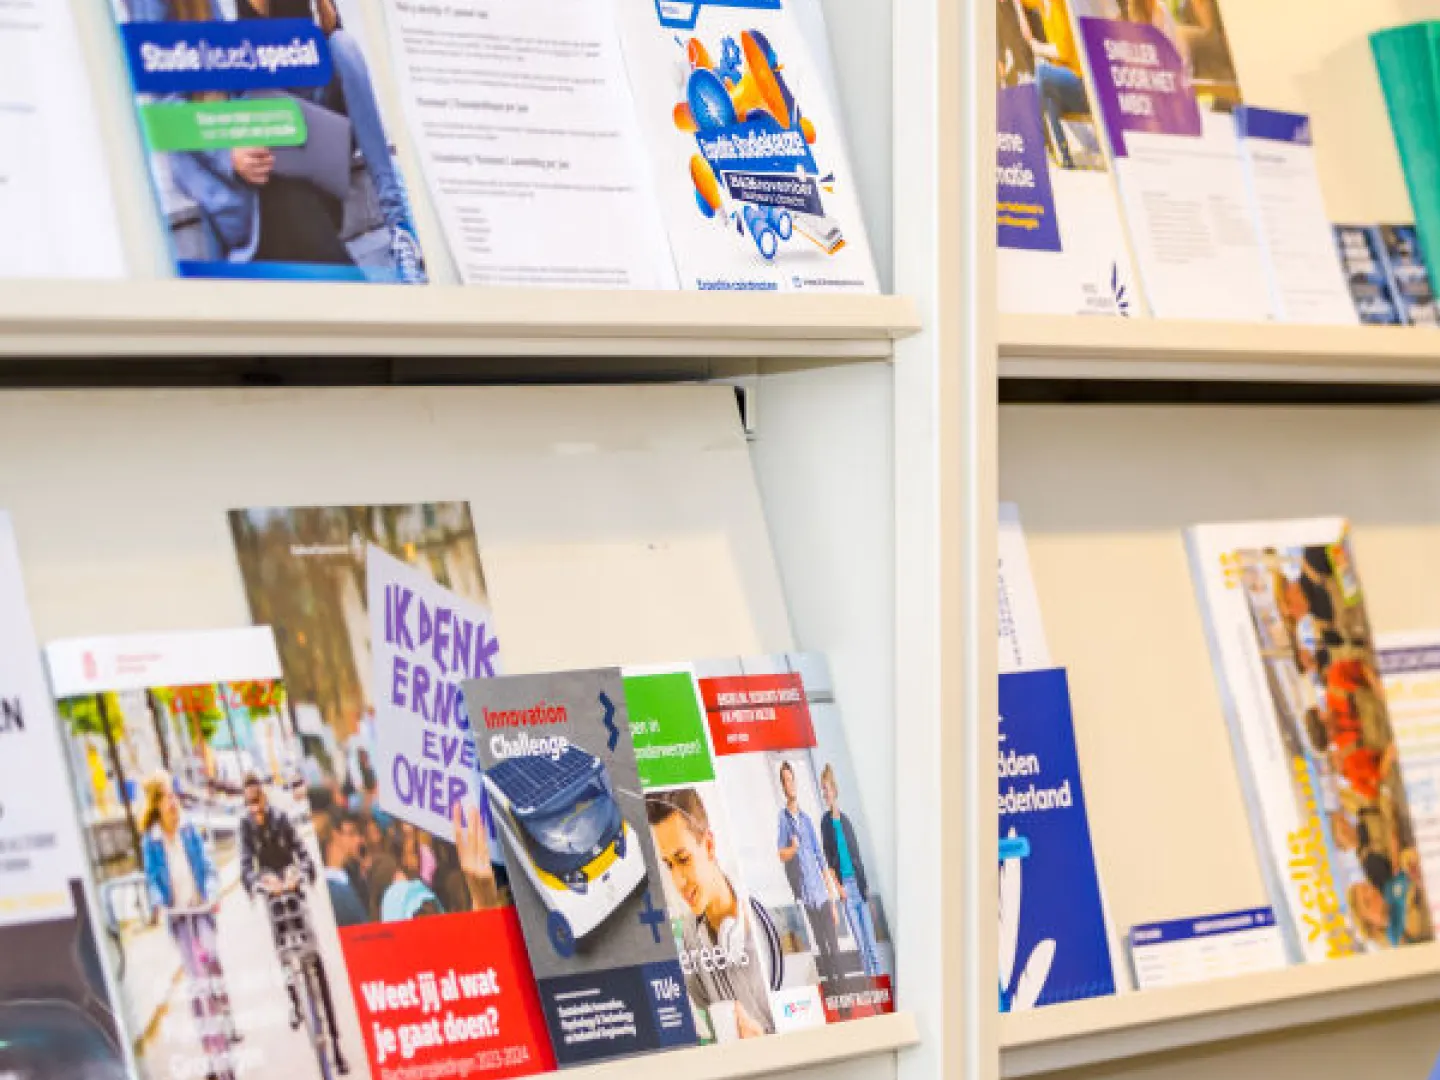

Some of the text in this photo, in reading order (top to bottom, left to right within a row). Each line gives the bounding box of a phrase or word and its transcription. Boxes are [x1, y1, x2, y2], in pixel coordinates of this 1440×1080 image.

[140, 41, 199, 71] Studie
[257, 37, 320, 74] special
[1103, 38, 1158, 65] SNELLER
[384, 584, 500, 679] IK DENK
[482, 699, 568, 730] Innovation
[490, 732, 569, 761] Challenge
[361, 967, 500, 1014] Weet jij al wat
[650, 976, 681, 1001] TU/e
[373, 1007, 500, 1064] je gaat doen?
